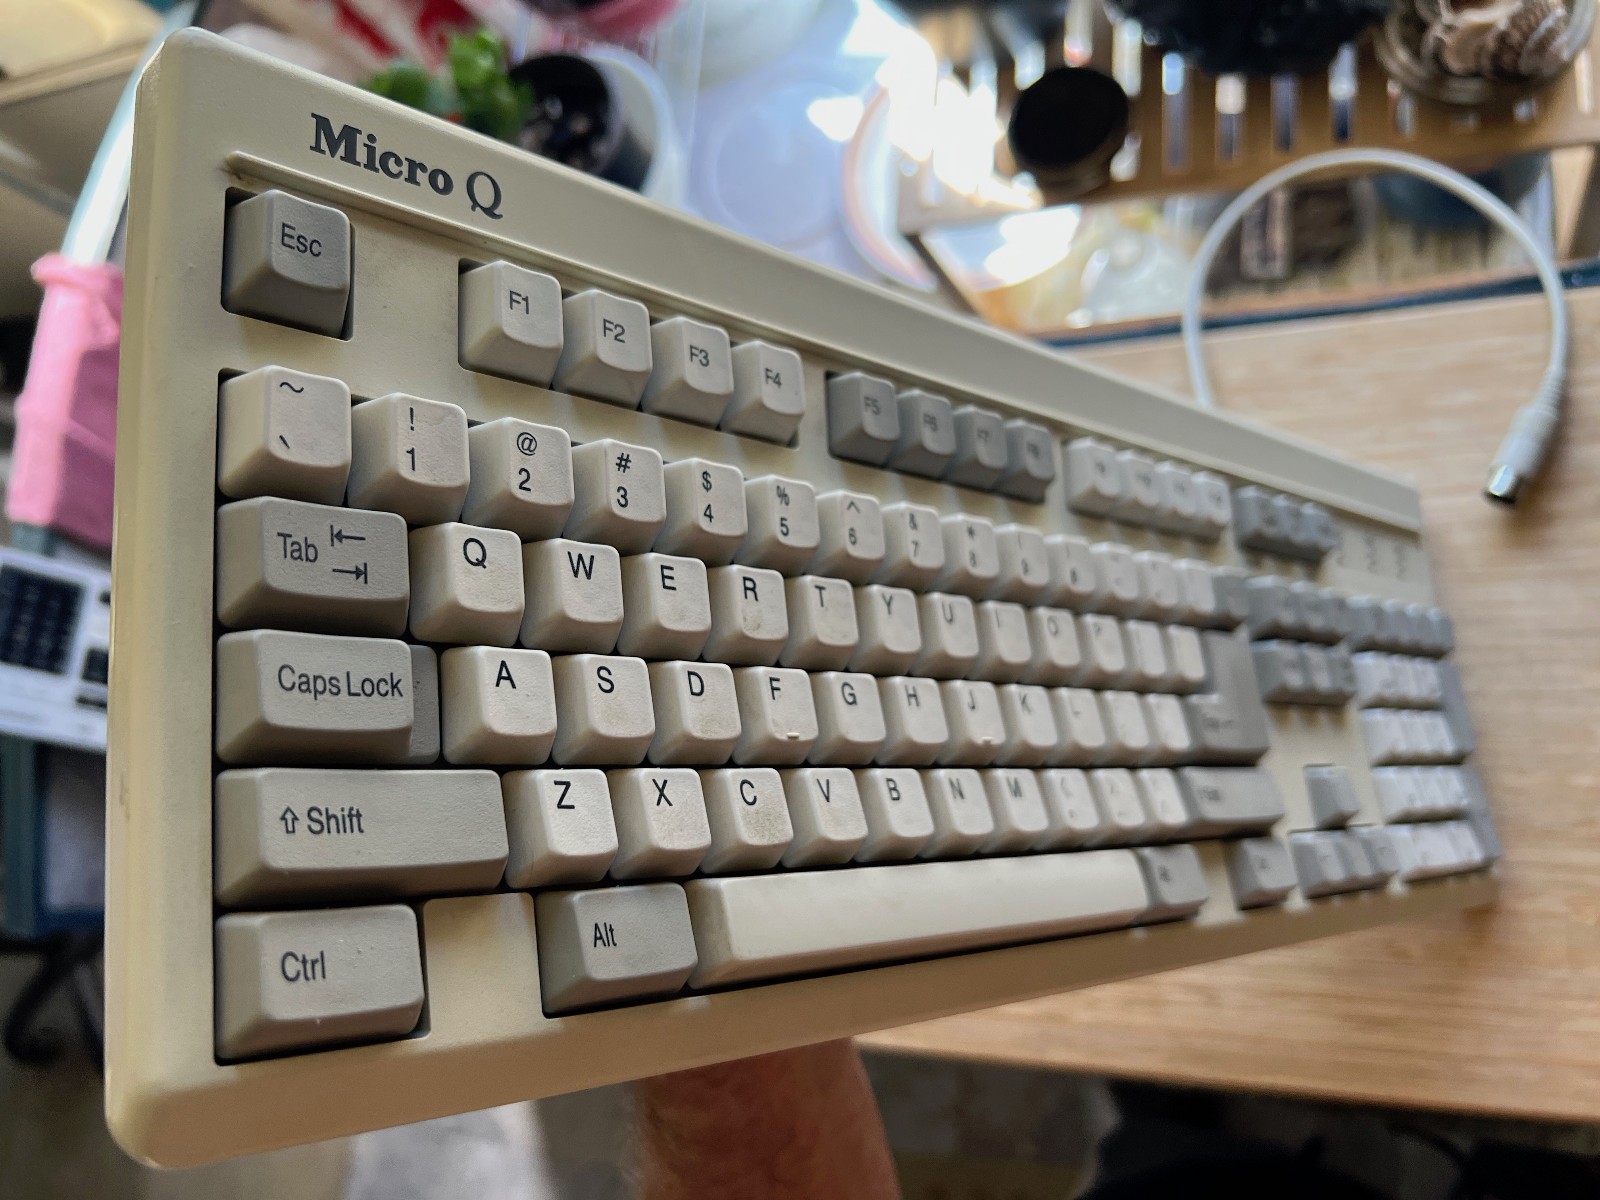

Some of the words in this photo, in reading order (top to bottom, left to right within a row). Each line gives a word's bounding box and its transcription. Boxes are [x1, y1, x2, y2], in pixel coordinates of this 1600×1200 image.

[310, 113, 453, 195] Micro
[466, 172, 503, 219] Q
[282, 223, 322, 257] Esc
[510, 290, 529, 314] F1
[603, 319, 625, 343] F2
[690, 345, 709, 367] F3
[280, 382, 304, 393] ~
[765, 368, 782, 388] F4
[409, 407, 415, 432] !
[517, 432, 537, 456] @
[406, 448, 415, 471] 1
[616, 453, 631, 473] #
[519, 468, 531, 491] 2
[702, 471, 712, 492] $
[617, 486, 628, 508] 3
[777, 486, 789, 506] %
[704, 504, 713, 522] 4
[780, 517, 789, 536] 5
[849, 528, 857, 545] 6
[277, 532, 318, 563] Tab
[463, 538, 486, 568] Q
[911, 541, 919, 558] 7
[568, 551, 594, 580] W
[661, 565, 676, 590] E
[743, 576, 758, 601] R
[814, 585, 826, 607] T
[882, 594, 893, 615] Y
[942, 603, 955, 624] U
[278, 664, 341, 700] Caps
[346, 670, 404, 698] Lock
[496, 660, 516, 689] A
[597, 666, 614, 693] S
[688, 671, 704, 696] D
[769, 677, 781, 700] F
[842, 682, 857, 705] G
[905, 686, 919, 707] H
[968, 691, 976, 710] J
[554, 780, 575, 809] Z
[652, 779, 673, 806] X
[740, 779, 757, 805] C
[817, 779, 830, 802] V
[886, 778, 900, 801] B
[949, 778, 965, 799] N
[1007, 778, 1022, 798] M
[307, 807, 364, 835] Shift
[594, 923, 617, 947] Alt
[281, 951, 326, 982] Ctrl
